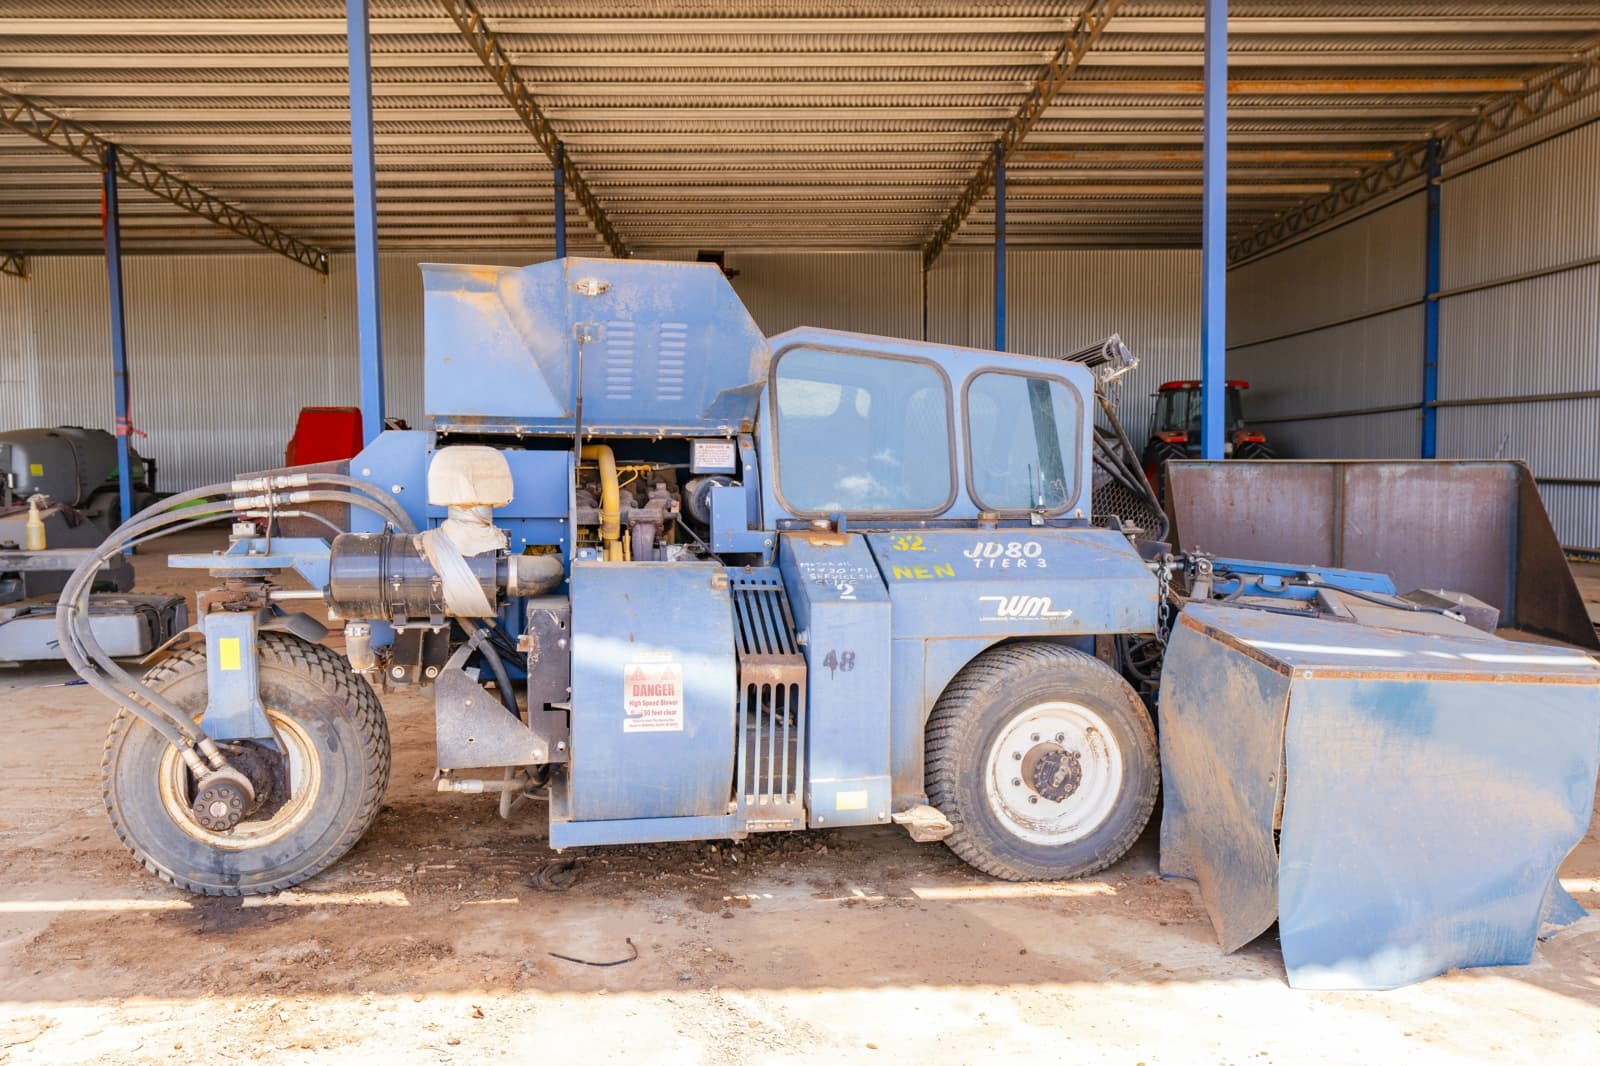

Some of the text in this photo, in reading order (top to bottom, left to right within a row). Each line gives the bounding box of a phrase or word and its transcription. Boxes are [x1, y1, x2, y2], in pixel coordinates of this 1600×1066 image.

[963, 541, 1042, 558] JD80
[892, 562, 956, 580] NEN
[973, 558, 1047, 568] TIER 3
[836, 583, 857, 600] 2
[822, 649, 856, 673] 48
[632, 683, 675, 697] DANGER
[628, 700, 642, 708] High
